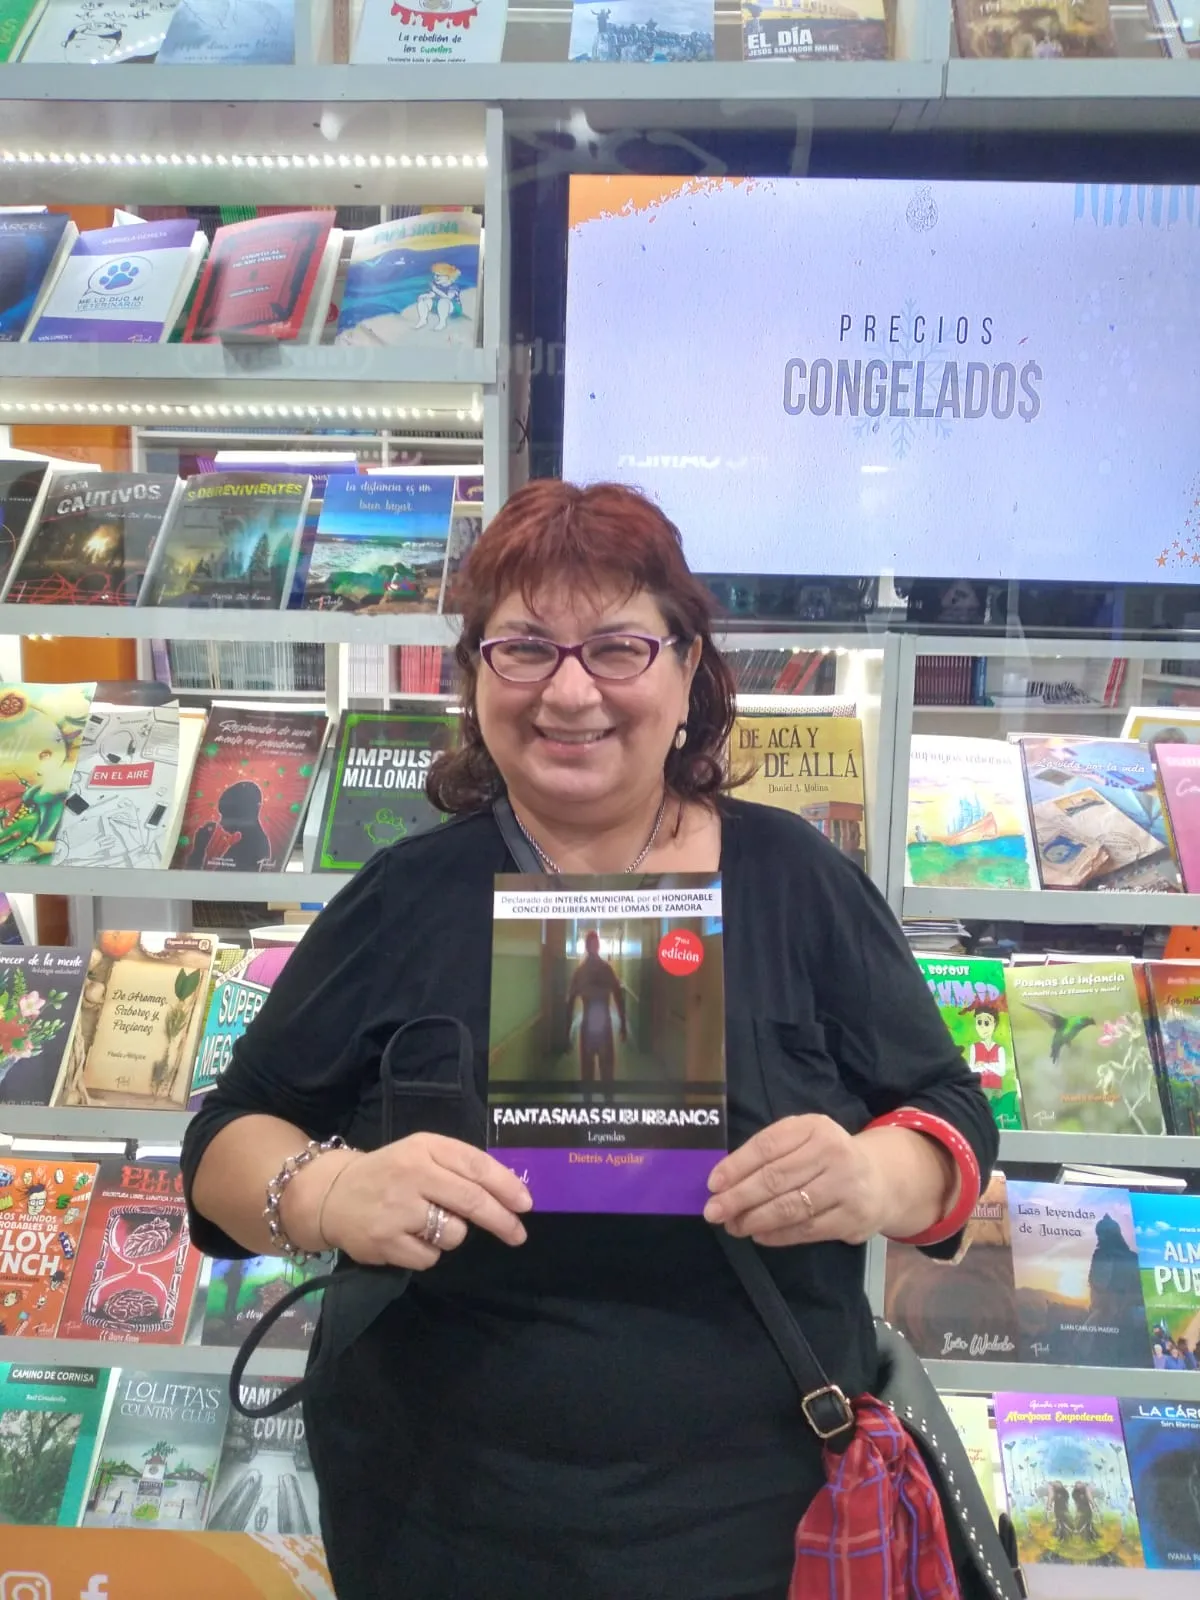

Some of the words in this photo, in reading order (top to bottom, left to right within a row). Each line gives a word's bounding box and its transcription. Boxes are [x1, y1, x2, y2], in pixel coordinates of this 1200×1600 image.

[747, 33, 771, 49] EL
[778, 26, 814, 46] DÍA
[839, 314, 993, 345] PRECIOS
[57, 484, 161, 515] CAUTIVOS
[739, 727, 763, 749] DE
[767, 725, 802, 749] ACÁ
[806, 728, 819, 749] Y
[764, 752, 794, 778] DE
[799, 749, 859, 778] ALLÁ
[93, 772, 108, 780] EN
[112, 771, 123, 780] EL
[127, 769, 150, 779] AIRE
[342, 768, 428, 789] MILLONAR
[768, 783, 793, 793] Daniel
[804, 783, 829, 793] Molina
[501, 894, 541, 904] Declarado
[542, 895, 553, 904] de
[555, 893, 588, 904] INTERÉS
[590, 894, 636, 904] MUNICIPAL
[637, 895, 654, 906] por
[654, 894, 661, 903] el
[662, 893, 713, 902] HONORABLE
[512, 905, 550, 914] CONCEJO
[552, 905, 606, 914] DELIBERANTE
[608, 904, 618, 913] DE
[621, 904, 650, 913] LOMAS
[652, 903, 663, 912] DE
[665, 903, 702, 912] ZAMORA
[0, 956, 25, 965] recer
[661, 947, 700, 963] edición
[1061, 975, 1076, 987] de
[218, 984, 264, 1024] SUPER
[200, 1034, 234, 1077] MEG
[493, 1107, 601, 1126] FANTASMAS
[601, 1107, 720, 1126] SUBURBANOS
[587, 1130, 626, 1143] Leyendas
[568, 1152, 603, 1164] Dietris
[605, 1153, 645, 1166] Aguilar
[18, 1213, 57, 1224] MUNDOS
[1017, 1203, 1041, 1216] Las
[1046, 1204, 1096, 1220] leyendas
[46, 1223, 59, 1232] DE
[1019, 1222, 1033, 1234] de
[1038, 1223, 1083, 1238] Juanca
[0, 1251, 60, 1276] NCH
[12, 1369, 43, 1379] CAMINO
[44, 1370, 56, 1380] DE
[57, 1372, 94, 1383] CORNISA
[125, 1380, 221, 1410] LOLITTA'S
[120, 1402, 177, 1420] COUNTRY
[181, 1407, 216, 1424] CLUB
[1004, 1411, 1051, 1424] Mariposa
[1055, 1410, 1114, 1425] Empoderada
[1138, 1404, 1162, 1417] LA
[253, 1416, 305, 1443] COVID
